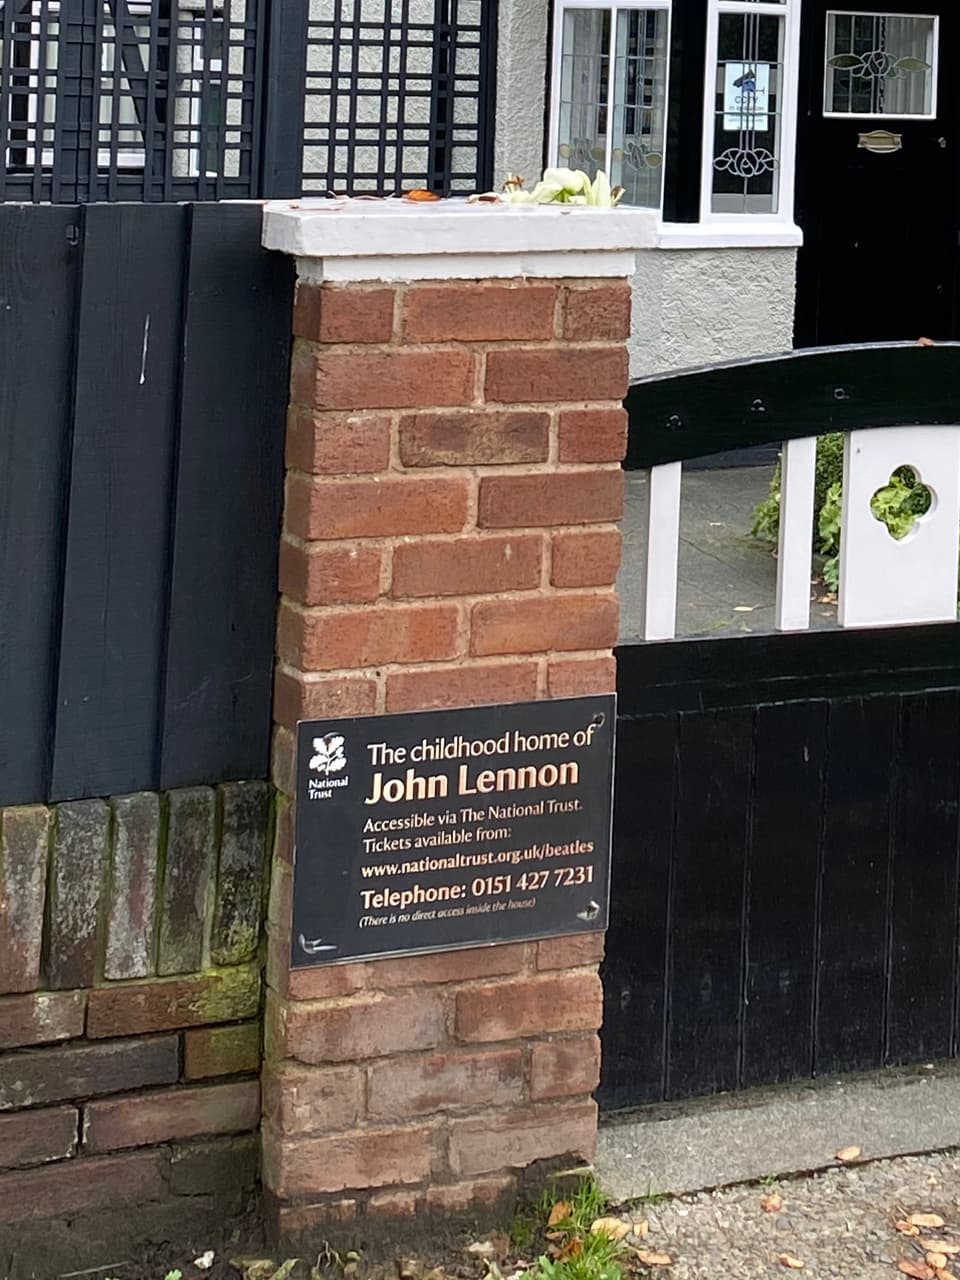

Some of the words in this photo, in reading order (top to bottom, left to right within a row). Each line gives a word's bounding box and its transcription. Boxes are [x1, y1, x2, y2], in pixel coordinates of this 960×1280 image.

[367, 742, 406, 766] The
[410, 732, 510, 762] childhood
[514, 730, 570, 752] home
[573, 724, 596, 746] of
[308, 789, 332, 800] Trust
[309, 776, 348, 789] National
[364, 768, 448, 804] John
[458, 762, 578, 796] Lennon
[363, 812, 434, 832] Accessible
[438, 810, 456, 824] via
[460, 808, 484, 823] The
[488, 800, 544, 820] National
[547, 799, 583, 814] Trust.
[362, 835, 412, 853] Tickets
[414, 830, 472, 848] available
[476, 826, 512, 842] from:
[361, 840, 594, 878] www.nationaltrust.org.uk/beatles
[360, 884, 467, 910] Telephone:
[472, 874, 512, 896] 0151
[516, 869, 550, 890] 427
[554, 864, 594, 886] 7231
[359, 914, 388, 928] (There
[389, 913, 397, 924] is
[398, 913, 410, 922] no
[412, 909, 436, 922] direct
[438, 908, 464, 918] access
[466, 904, 492, 915] inside
[492, 902, 504, 912] the
[508, 898, 536, 910] house)
